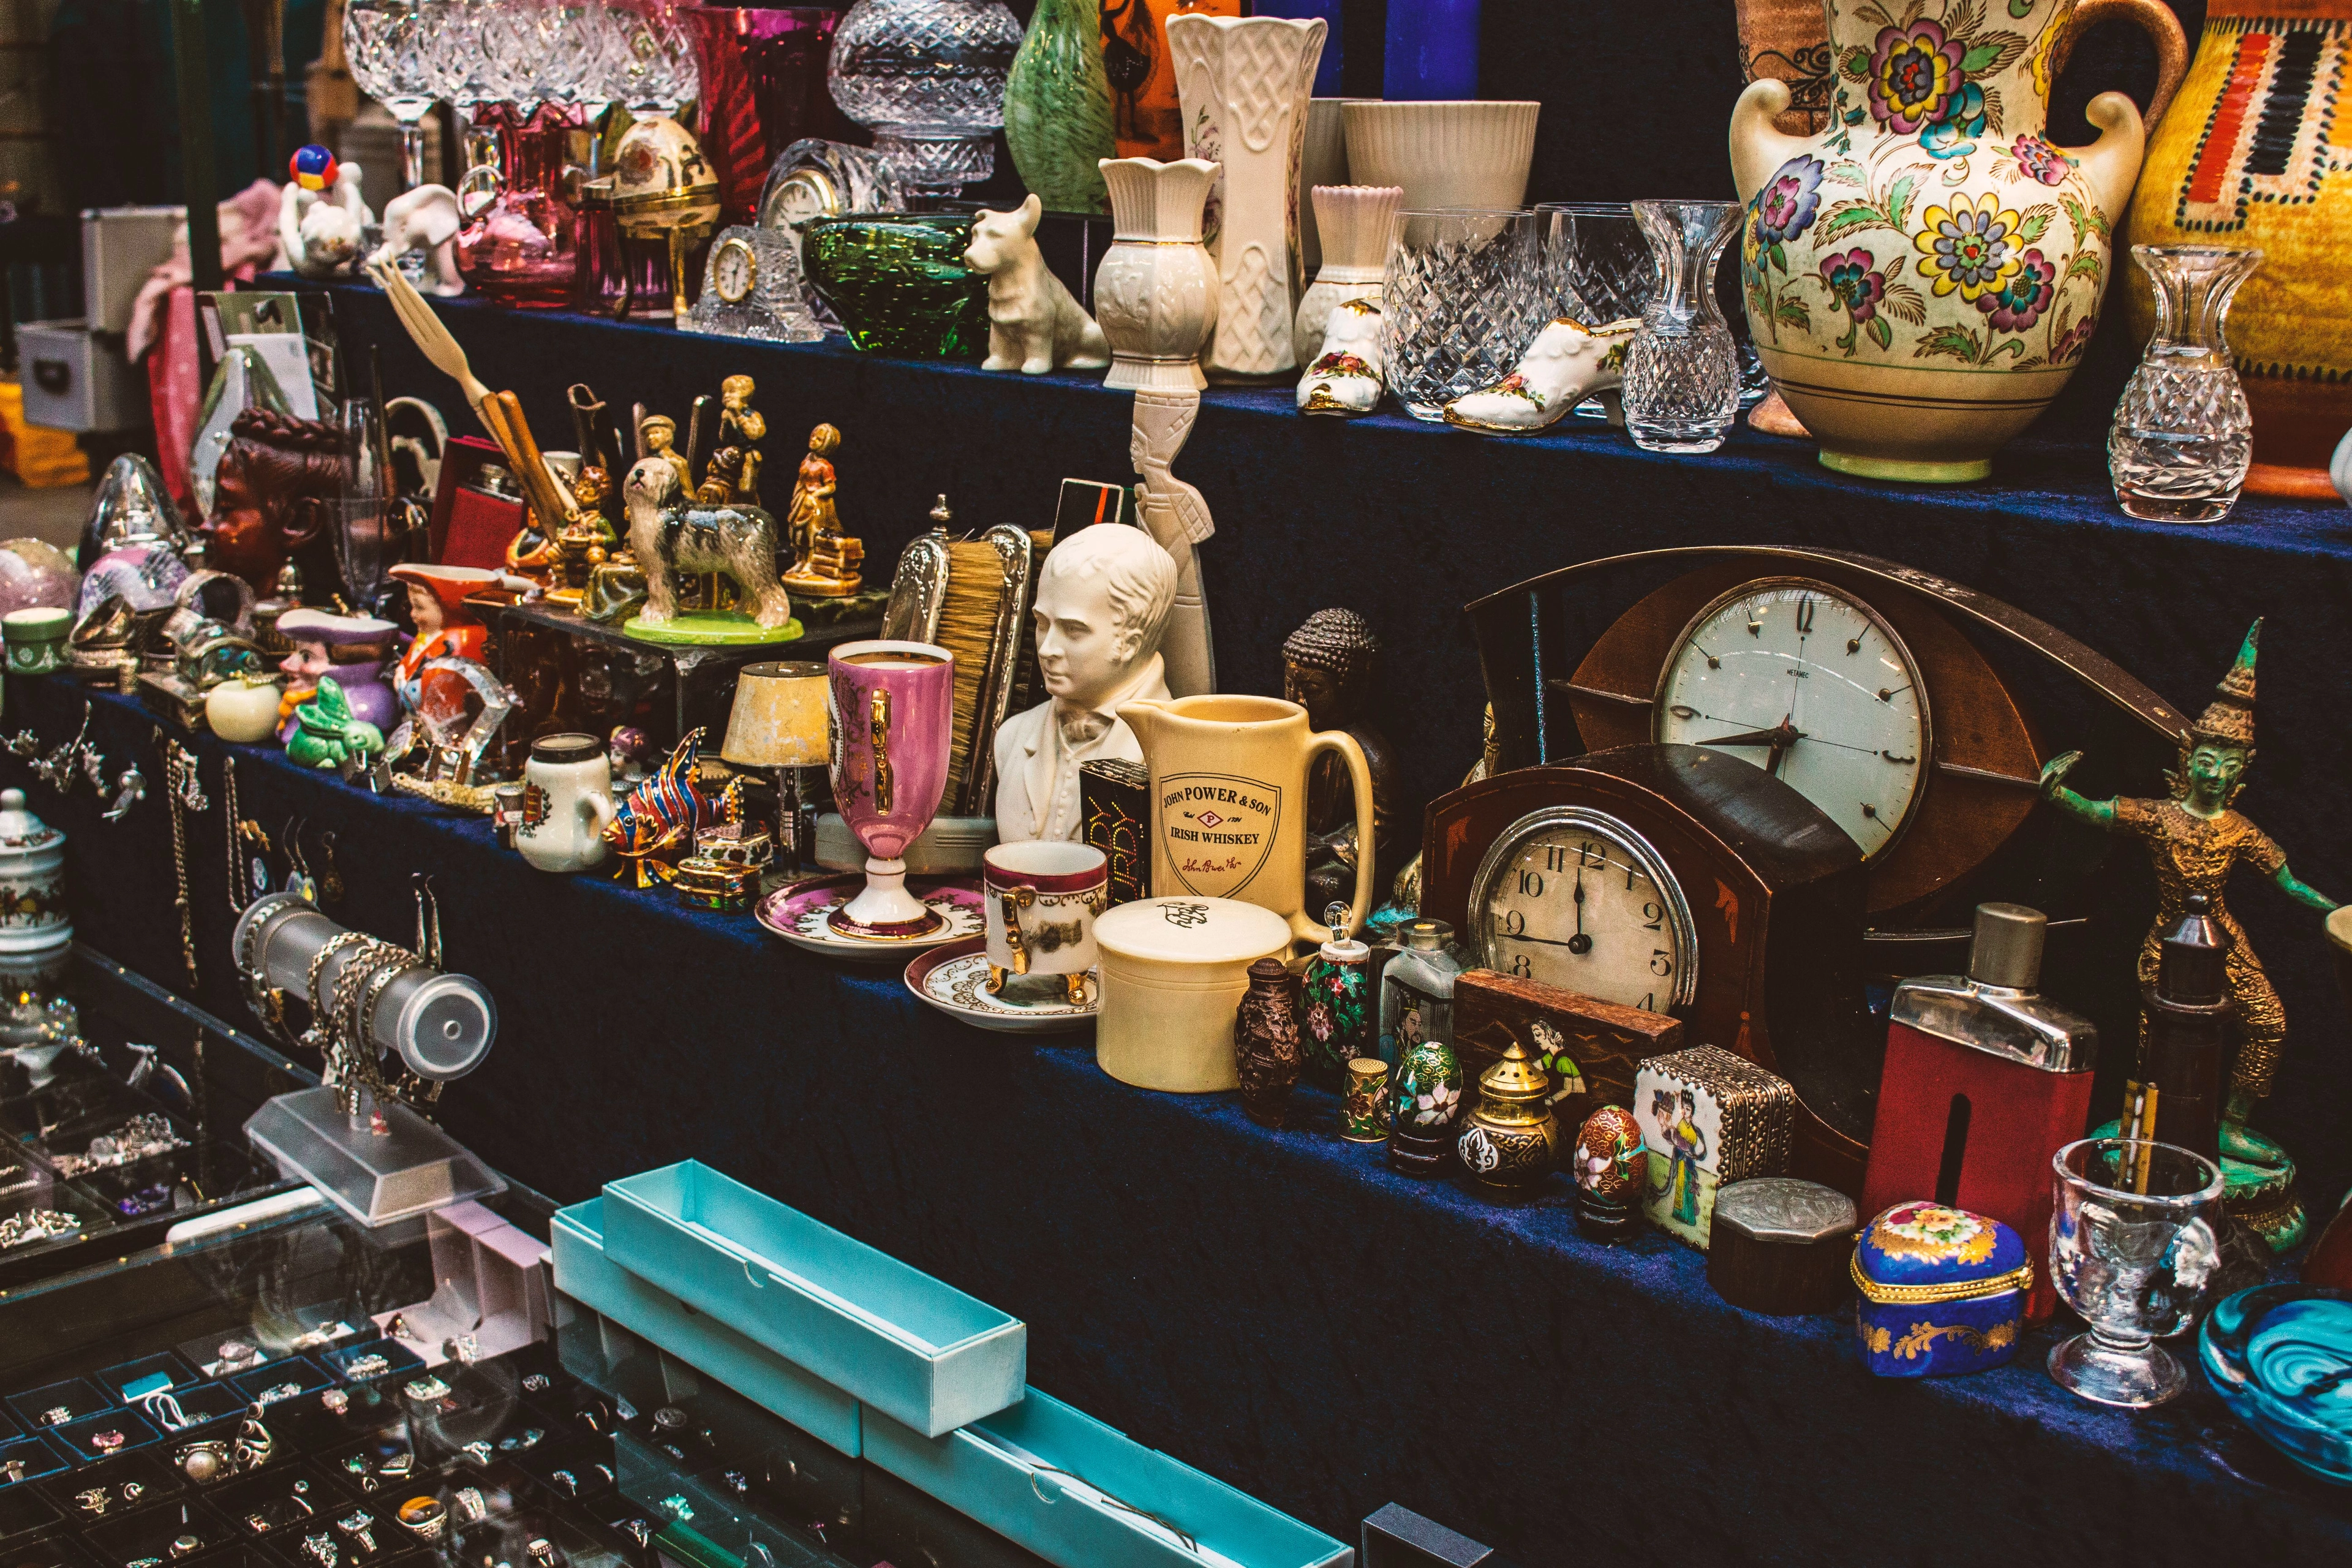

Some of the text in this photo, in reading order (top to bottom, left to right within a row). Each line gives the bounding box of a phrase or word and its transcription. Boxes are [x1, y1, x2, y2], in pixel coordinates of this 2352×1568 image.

[1796, 592, 1814, 633] 12
[1786, 669, 1809, 679] METAMEC
[1164, 786, 1272, 816] JOHN POWER & SON
[1207, 815, 1215, 823] P
[1170, 826, 1260, 845] IRISH WHISKEY
[1111, 801, 1138, 905] URDY
[1182, 858, 1201, 872] John
[1202, 859, 1226, 873] Power
[1547, 845, 1564, 873] 11
[1578, 841, 1606, 871] 12
[1518, 869, 1544, 897] 10
[1625, 864, 1634, 891] 1
[1506, 910, 1525, 935] 9
[1643, 903, 1664, 931] 2
[1513, 954, 1531, 979] 8
[1650, 949, 1672, 977] 3
[1635, 992, 1657, 1012] 4
